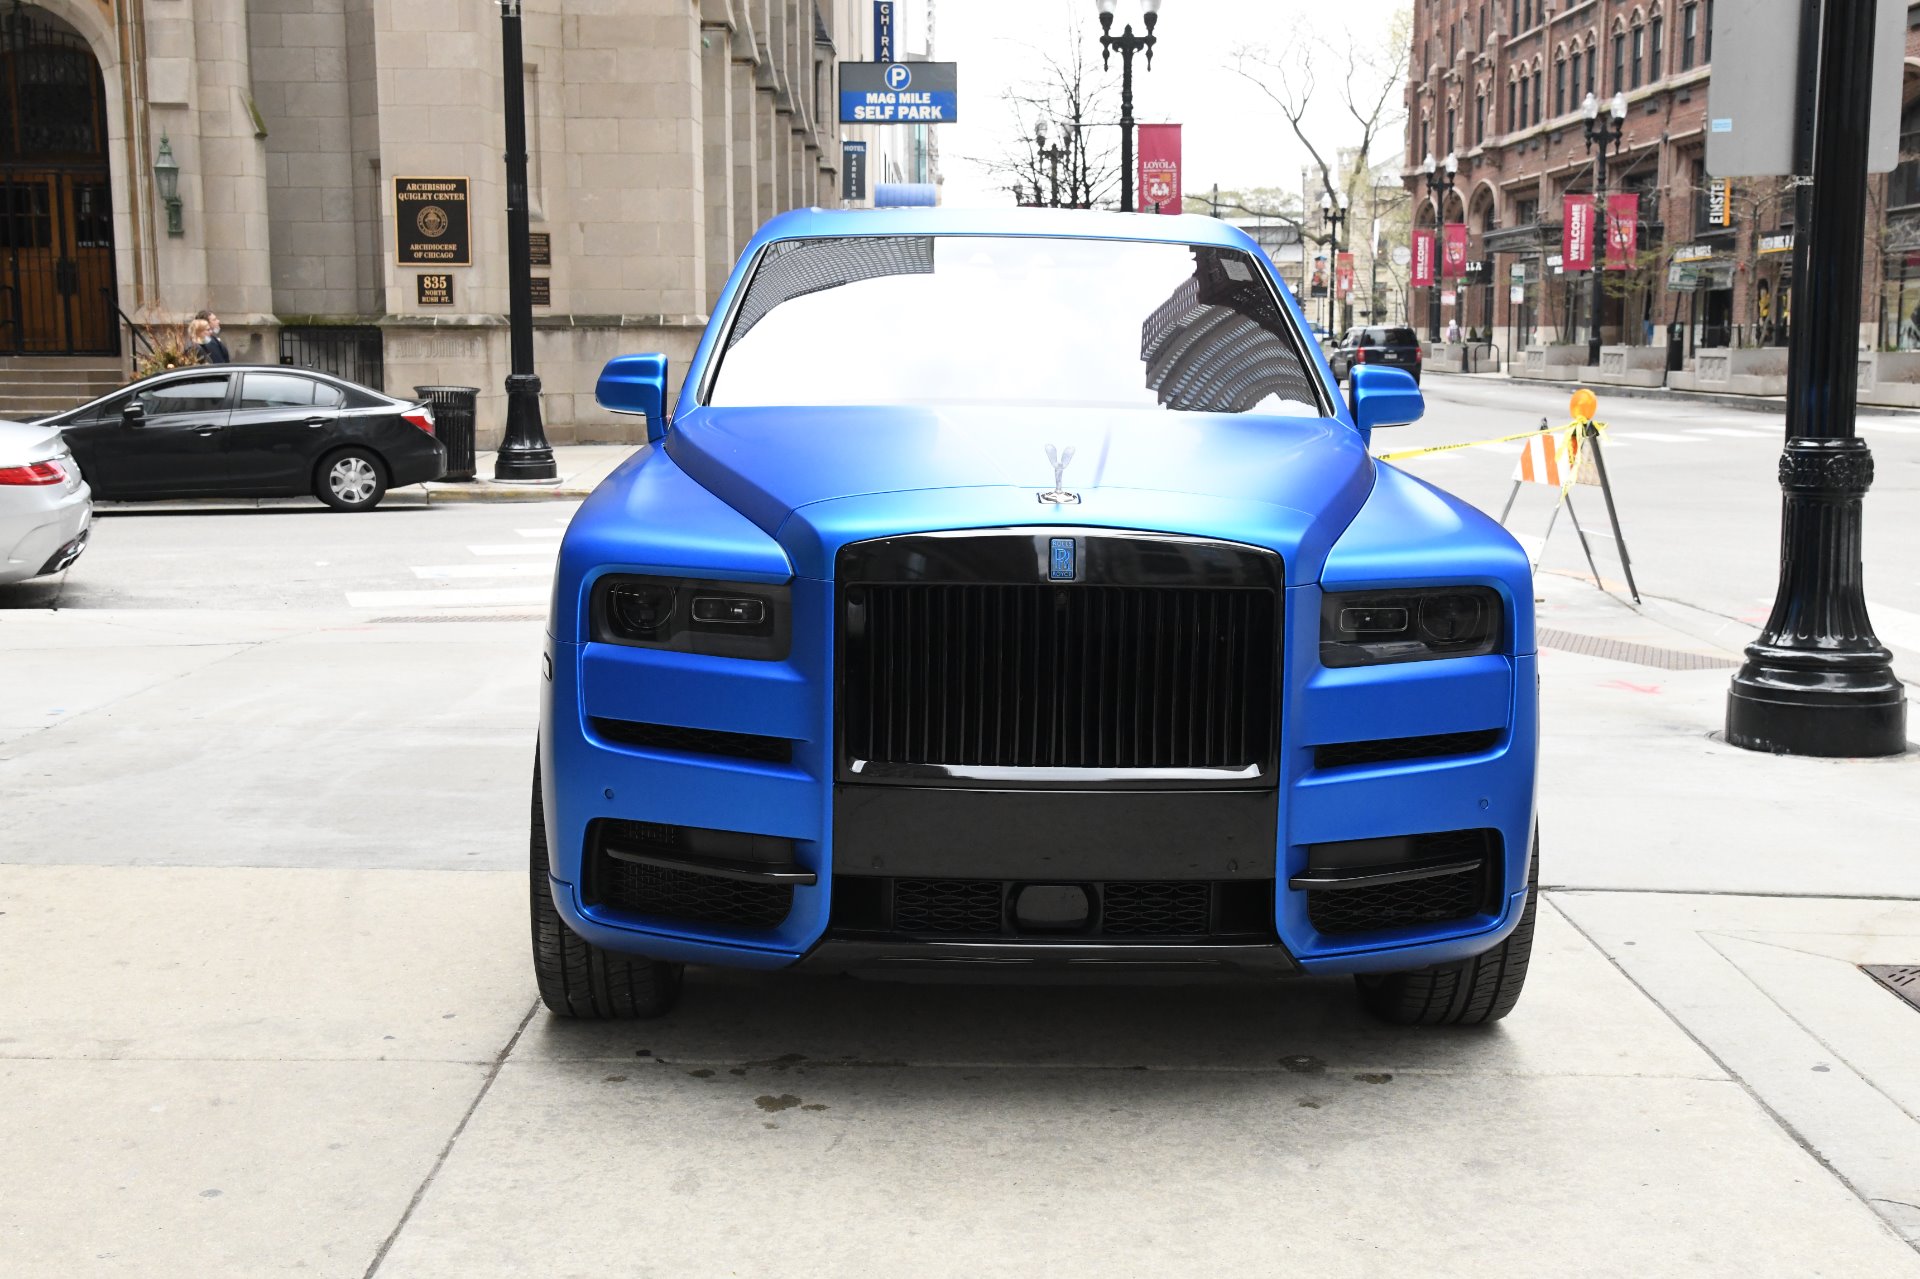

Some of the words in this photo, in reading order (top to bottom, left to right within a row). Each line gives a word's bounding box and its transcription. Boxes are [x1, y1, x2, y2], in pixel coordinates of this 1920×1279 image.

[891, 68, 906, 87] P
[866, 93, 896, 104] MAG
[899, 93, 931, 104] MILE
[854, 106, 894, 119] SELF
[898, 106, 942, 119] PARK
[1143, 161, 1177, 169] LOYOLA
[406, 183, 456, 191] ARCHBISHOP
[398, 192, 432, 201] QUIGLEY
[434, 192, 465, 201] CENTER
[1570, 204, 1581, 261] WELCOME
[410, 243, 457, 251] ARCHDIOCESE
[414, 251, 423, 259] OF
[424, 251, 454, 259] CHICAGO
[1416, 236, 1425, 280] WELCOME
[423, 276, 447, 289] 835
